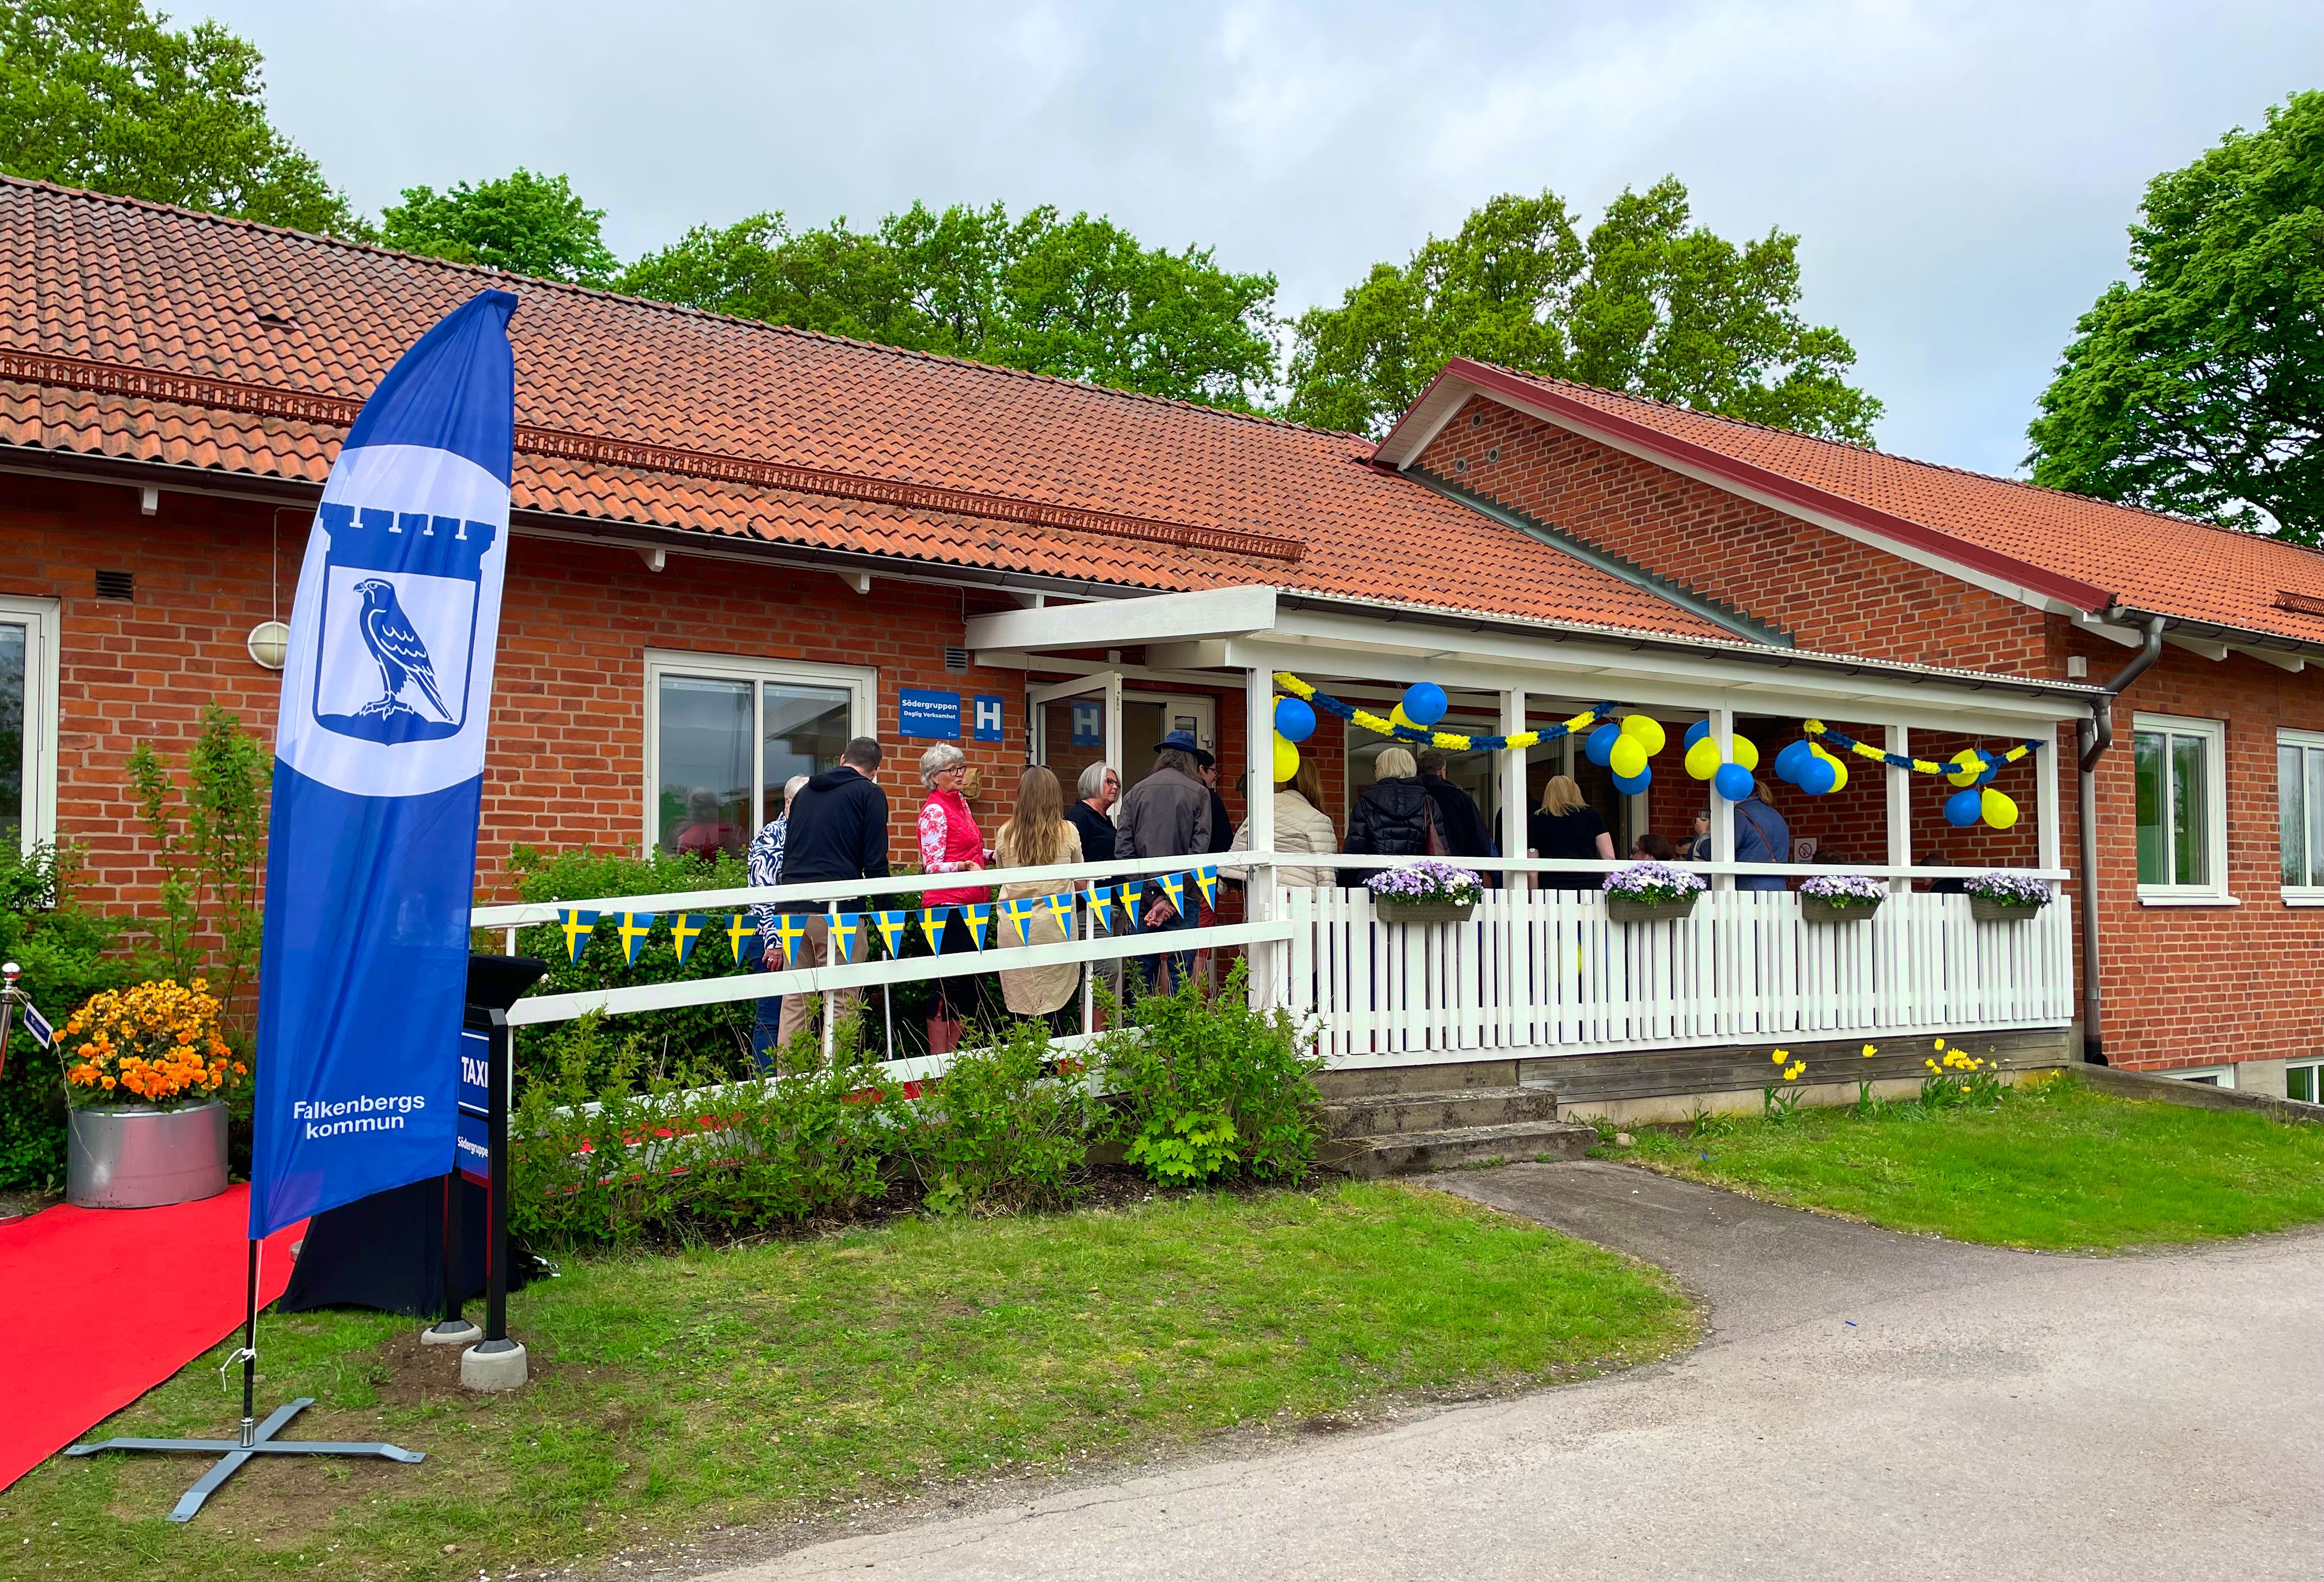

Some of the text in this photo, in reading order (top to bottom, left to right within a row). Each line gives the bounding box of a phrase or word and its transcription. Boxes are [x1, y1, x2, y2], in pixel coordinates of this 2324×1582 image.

[901, 699, 957, 710] Södergruppen
[976, 701, 1001, 730] H
[461, 1056, 488, 1088] TAXI
[293, 1095, 425, 1119] Falkenbergs
[306, 1116, 404, 1139] kommun
[458, 1136, 488, 1158] Södergruppe
